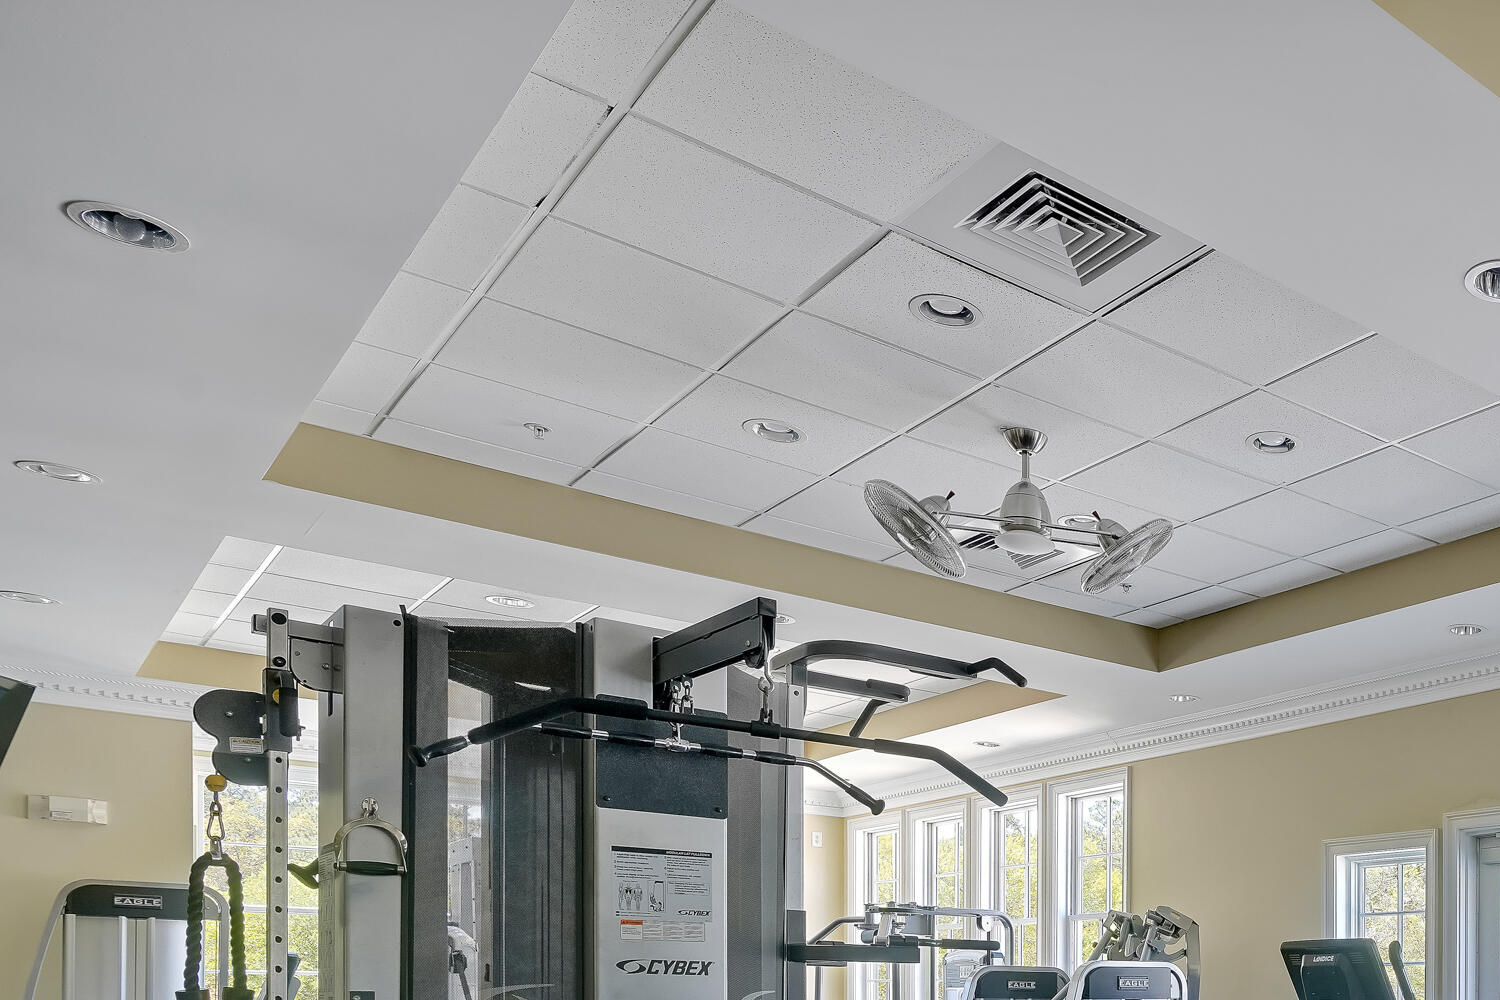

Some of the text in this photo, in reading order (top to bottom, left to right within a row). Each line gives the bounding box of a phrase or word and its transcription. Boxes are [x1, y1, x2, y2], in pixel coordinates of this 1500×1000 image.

[114, 896, 162, 906] EAGLE
[647, 959, 713, 976] CYBEX
[1008, 981, 1036, 989] EAGLE
[1120, 978, 1149, 987] EAGLE
